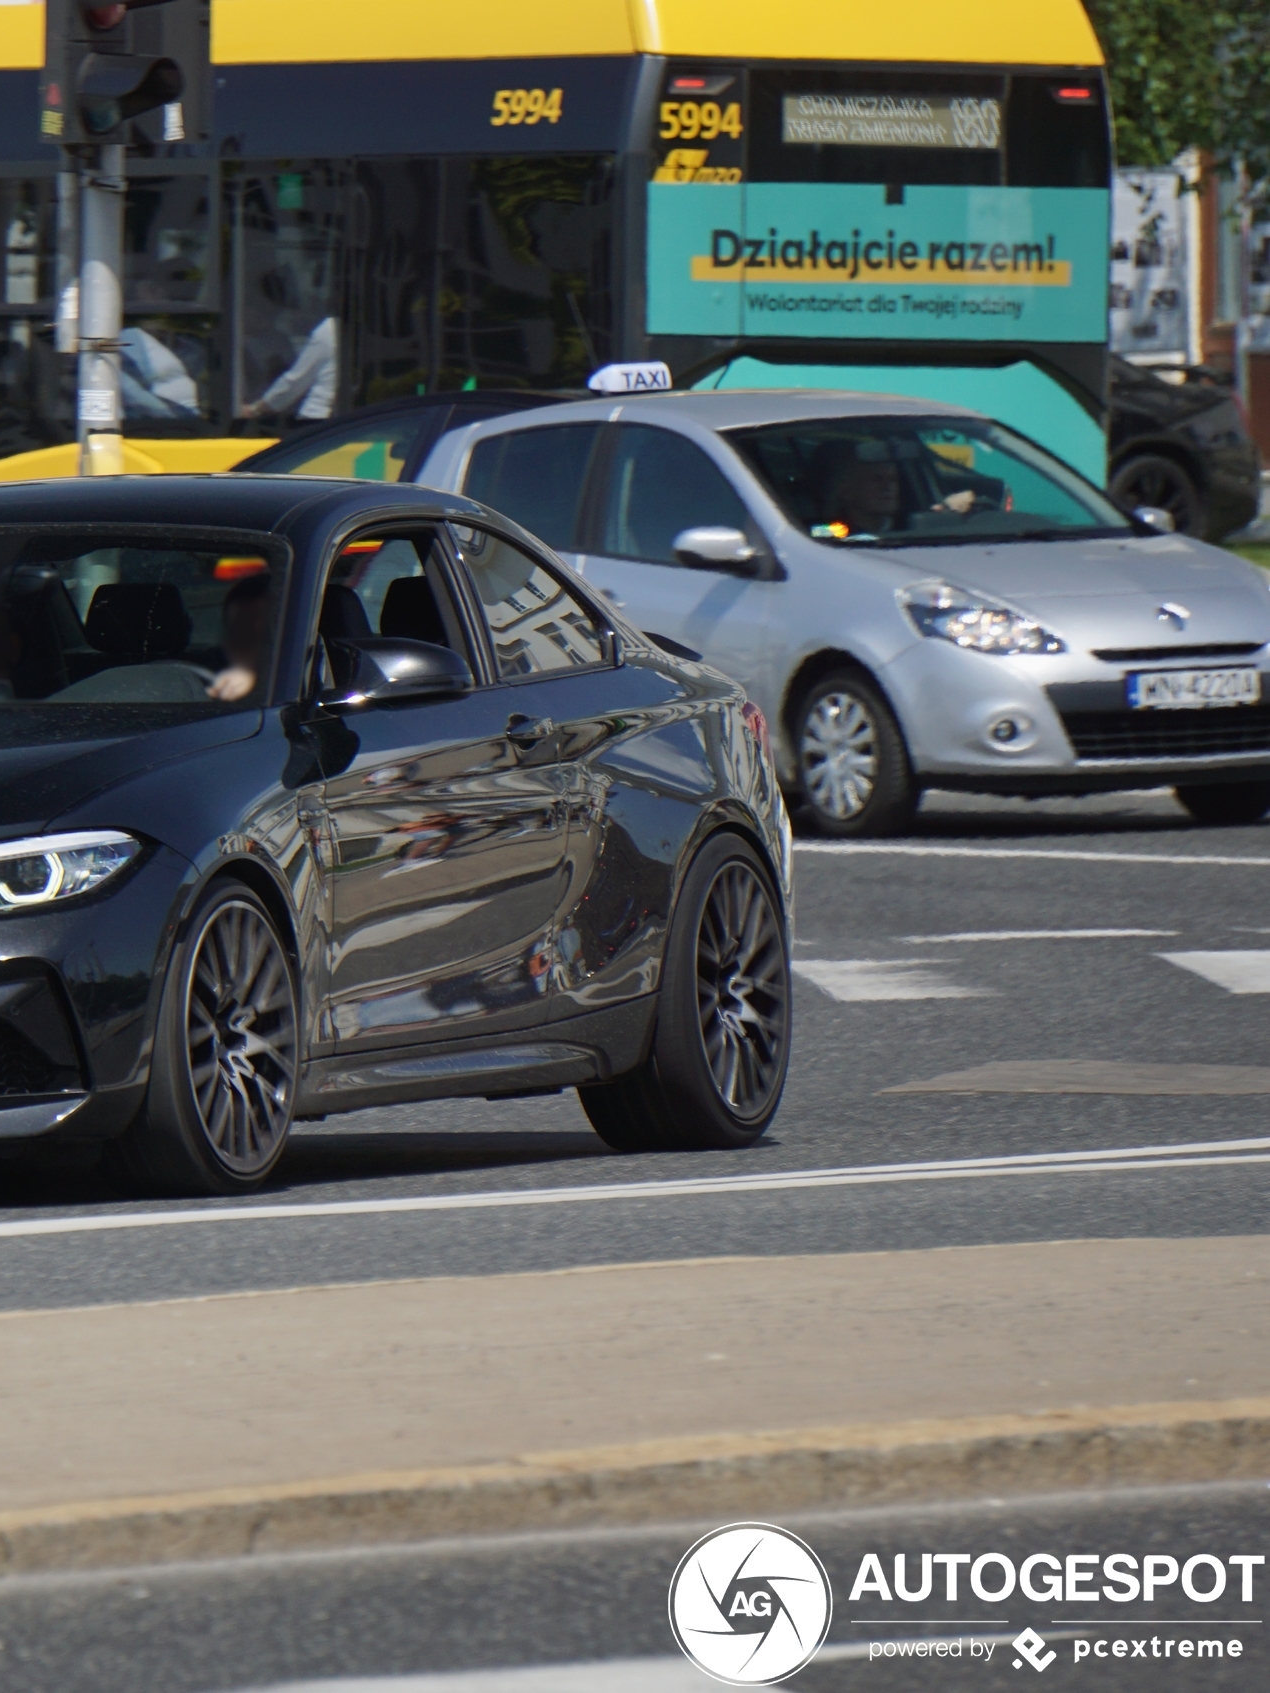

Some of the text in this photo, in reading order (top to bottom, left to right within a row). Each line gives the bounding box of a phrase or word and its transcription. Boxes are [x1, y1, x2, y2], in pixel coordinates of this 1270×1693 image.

[490, 88, 564, 126] 5994
[659, 102, 743, 140] 5994
[711, 228, 1056, 279] Działajcie razem!
[747, 294, 864, 312] Wolontariat
[866, 294, 897, 313] dla
[959, 295, 1024, 320] rodziny
[622, 371, 668, 389] TAXI
